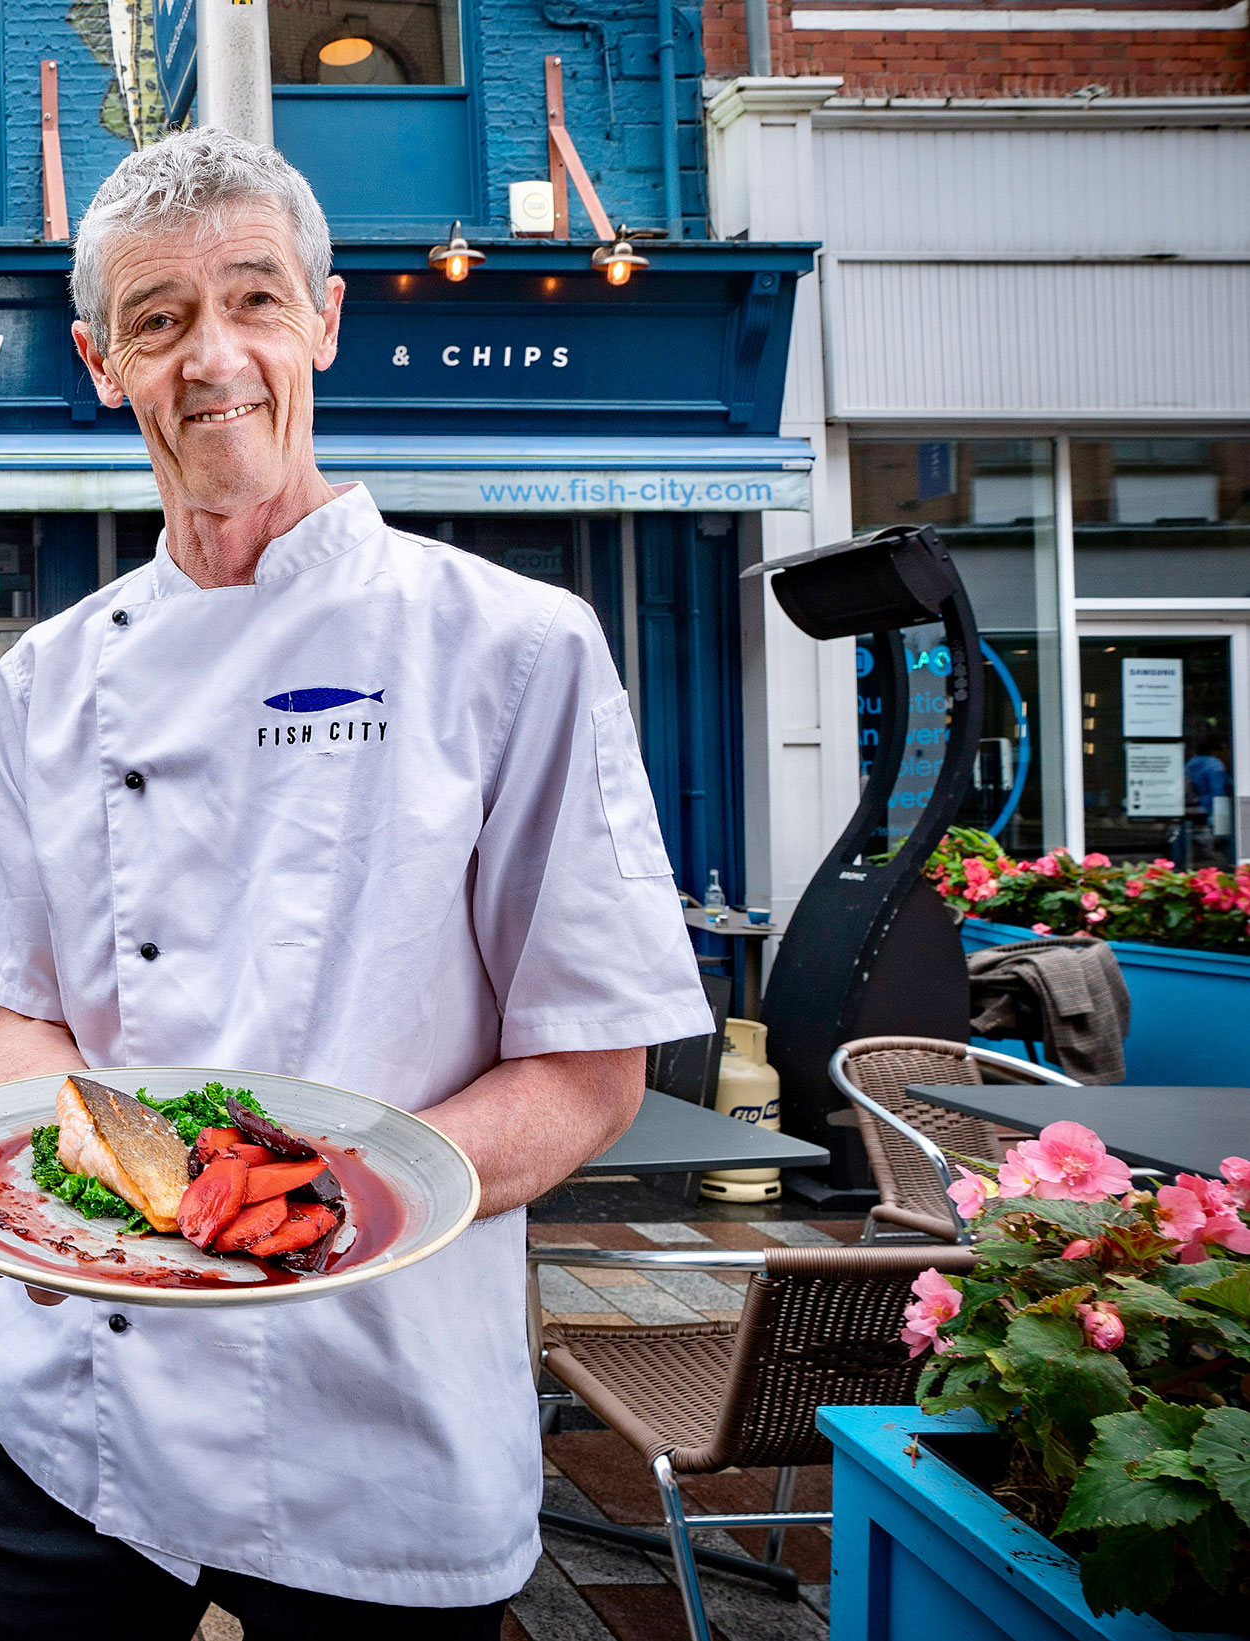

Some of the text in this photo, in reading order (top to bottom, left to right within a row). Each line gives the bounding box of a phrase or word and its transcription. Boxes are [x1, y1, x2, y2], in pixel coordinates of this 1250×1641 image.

[392, 345, 569, 367] & CHIPS
[480, 478, 772, 507] www.fish-city.com
[258, 721, 388, 747] FISH CITY
